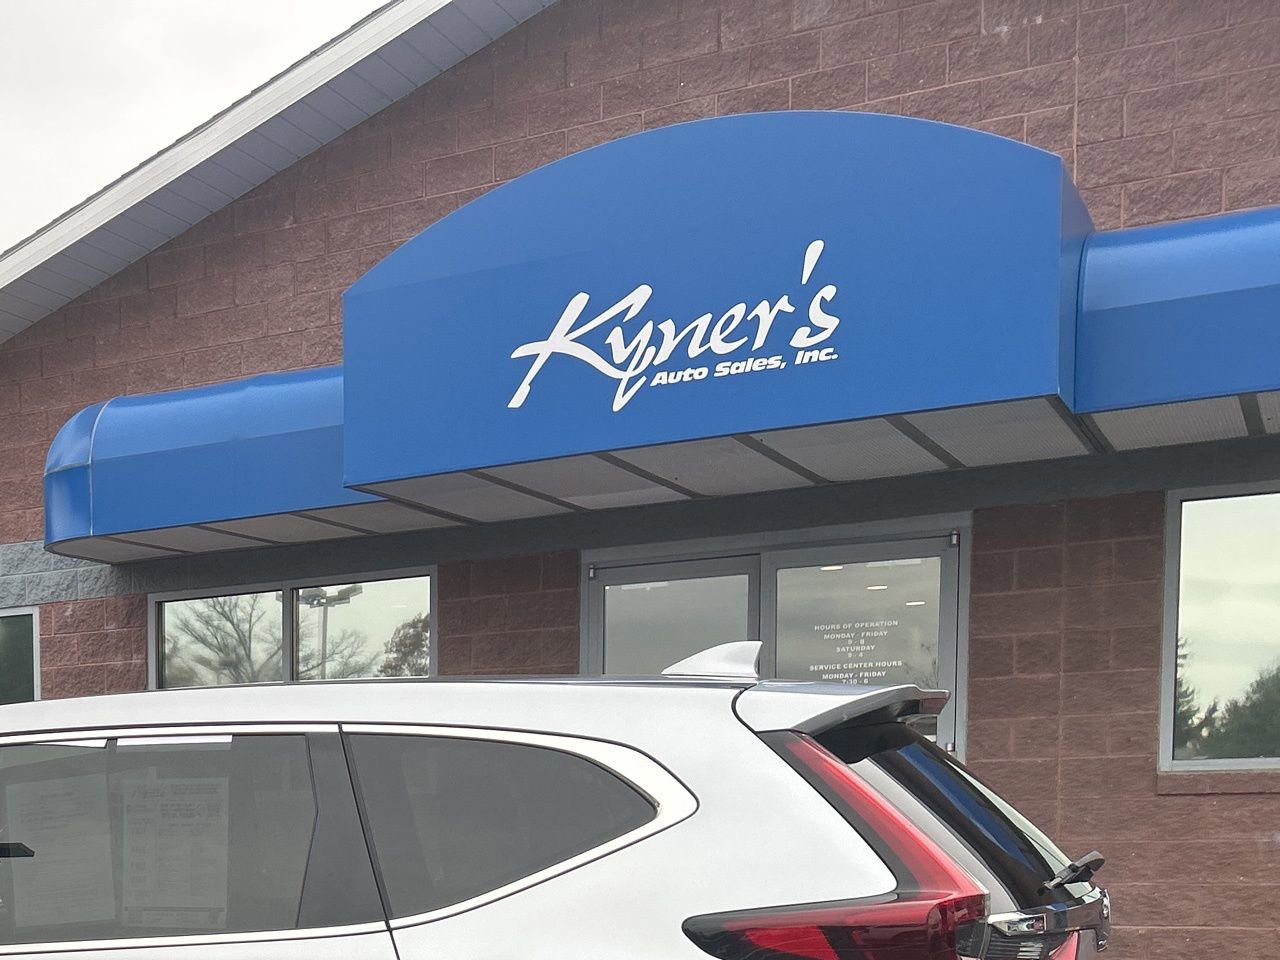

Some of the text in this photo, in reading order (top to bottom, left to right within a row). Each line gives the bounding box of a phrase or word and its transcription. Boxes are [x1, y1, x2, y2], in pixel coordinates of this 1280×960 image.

[507, 238, 841, 413] Kyner's
[650, 347, 838, 387] Auto Sales, Inc.
[854, 619, 898, 629] OPERATION
[823, 632, 856, 640] MONDAY
[861, 630, 888, 638] FRIDAY
[836, 645, 876, 653] SATURDAY
[843, 661, 874, 669] CENTER
[875, 660, 903, 668] HOURS
[822, 672, 854, 680] MONDAY
